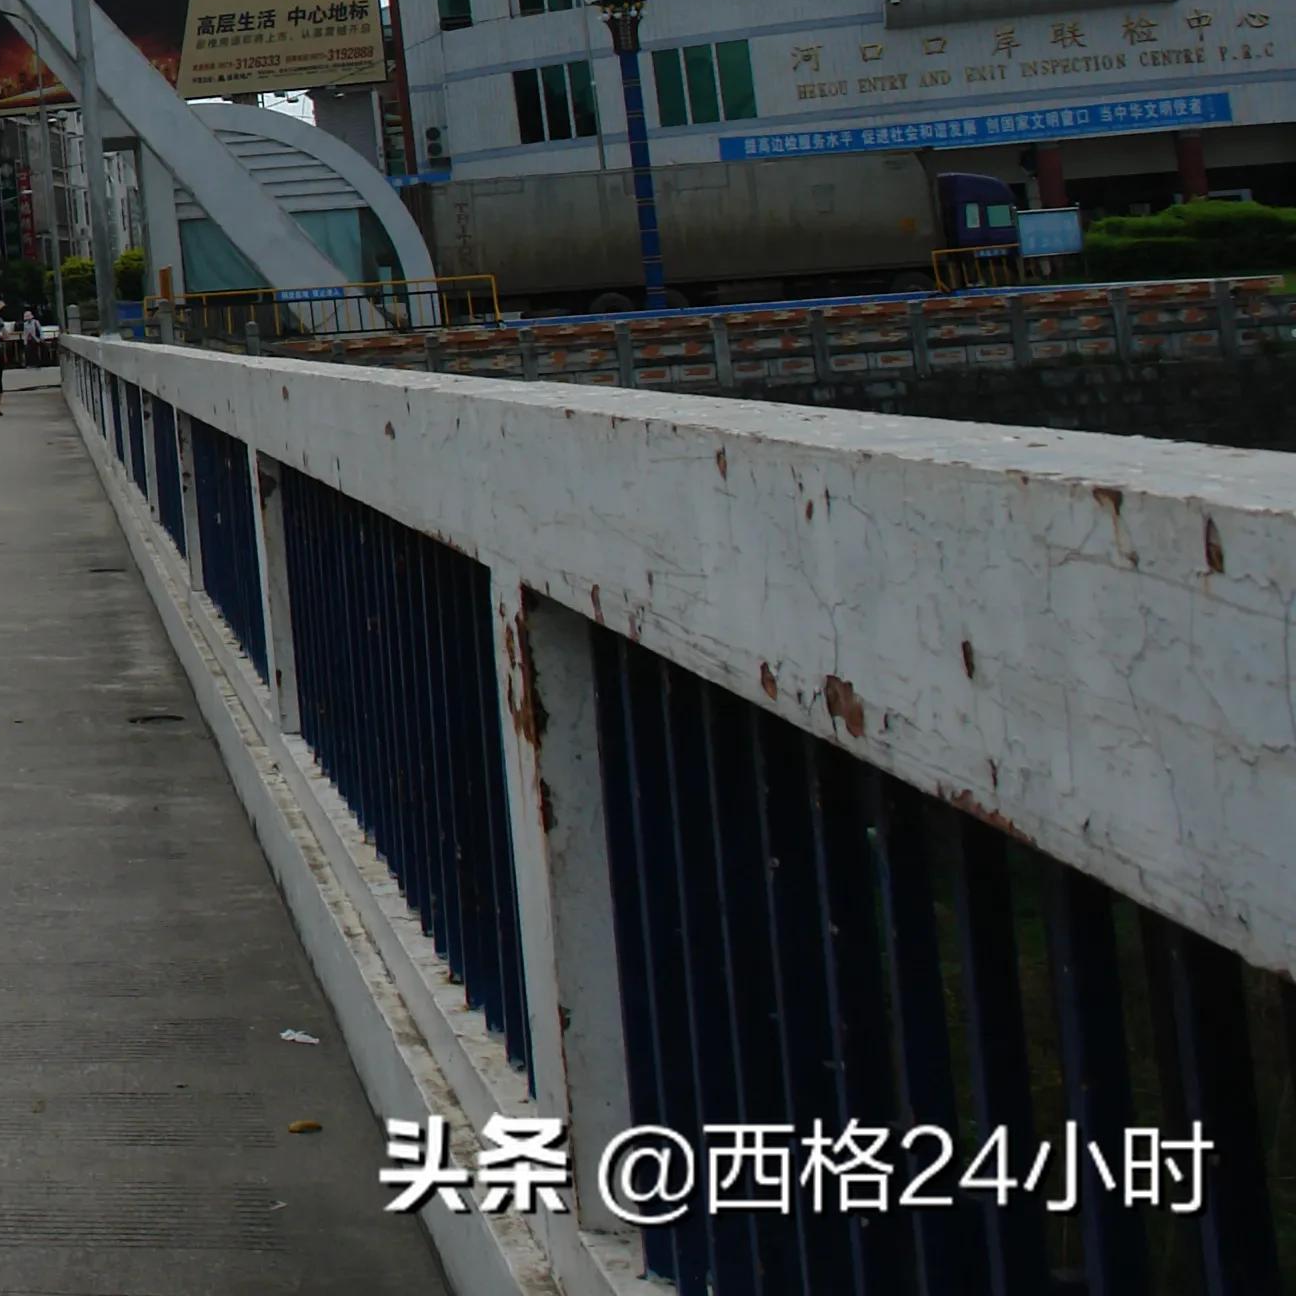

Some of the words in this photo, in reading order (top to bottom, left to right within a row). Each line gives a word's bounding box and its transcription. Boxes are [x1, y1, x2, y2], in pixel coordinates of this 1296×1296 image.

[196, 8, 276, 36] 高层生活
[287, 0, 369, 27] 中心地标
[790, 9, 1270, 72] 河口口岸联检中心
[797, 80, 848, 100] HEKOU
[858, 73, 908, 94] ENTRY
[919, 70, 952, 88] AND
[965, 64, 1007, 83] EXIT
[1019, 53, 1127, 78] INSPECTION
[1139, 47, 1205, 67] CENTRE
